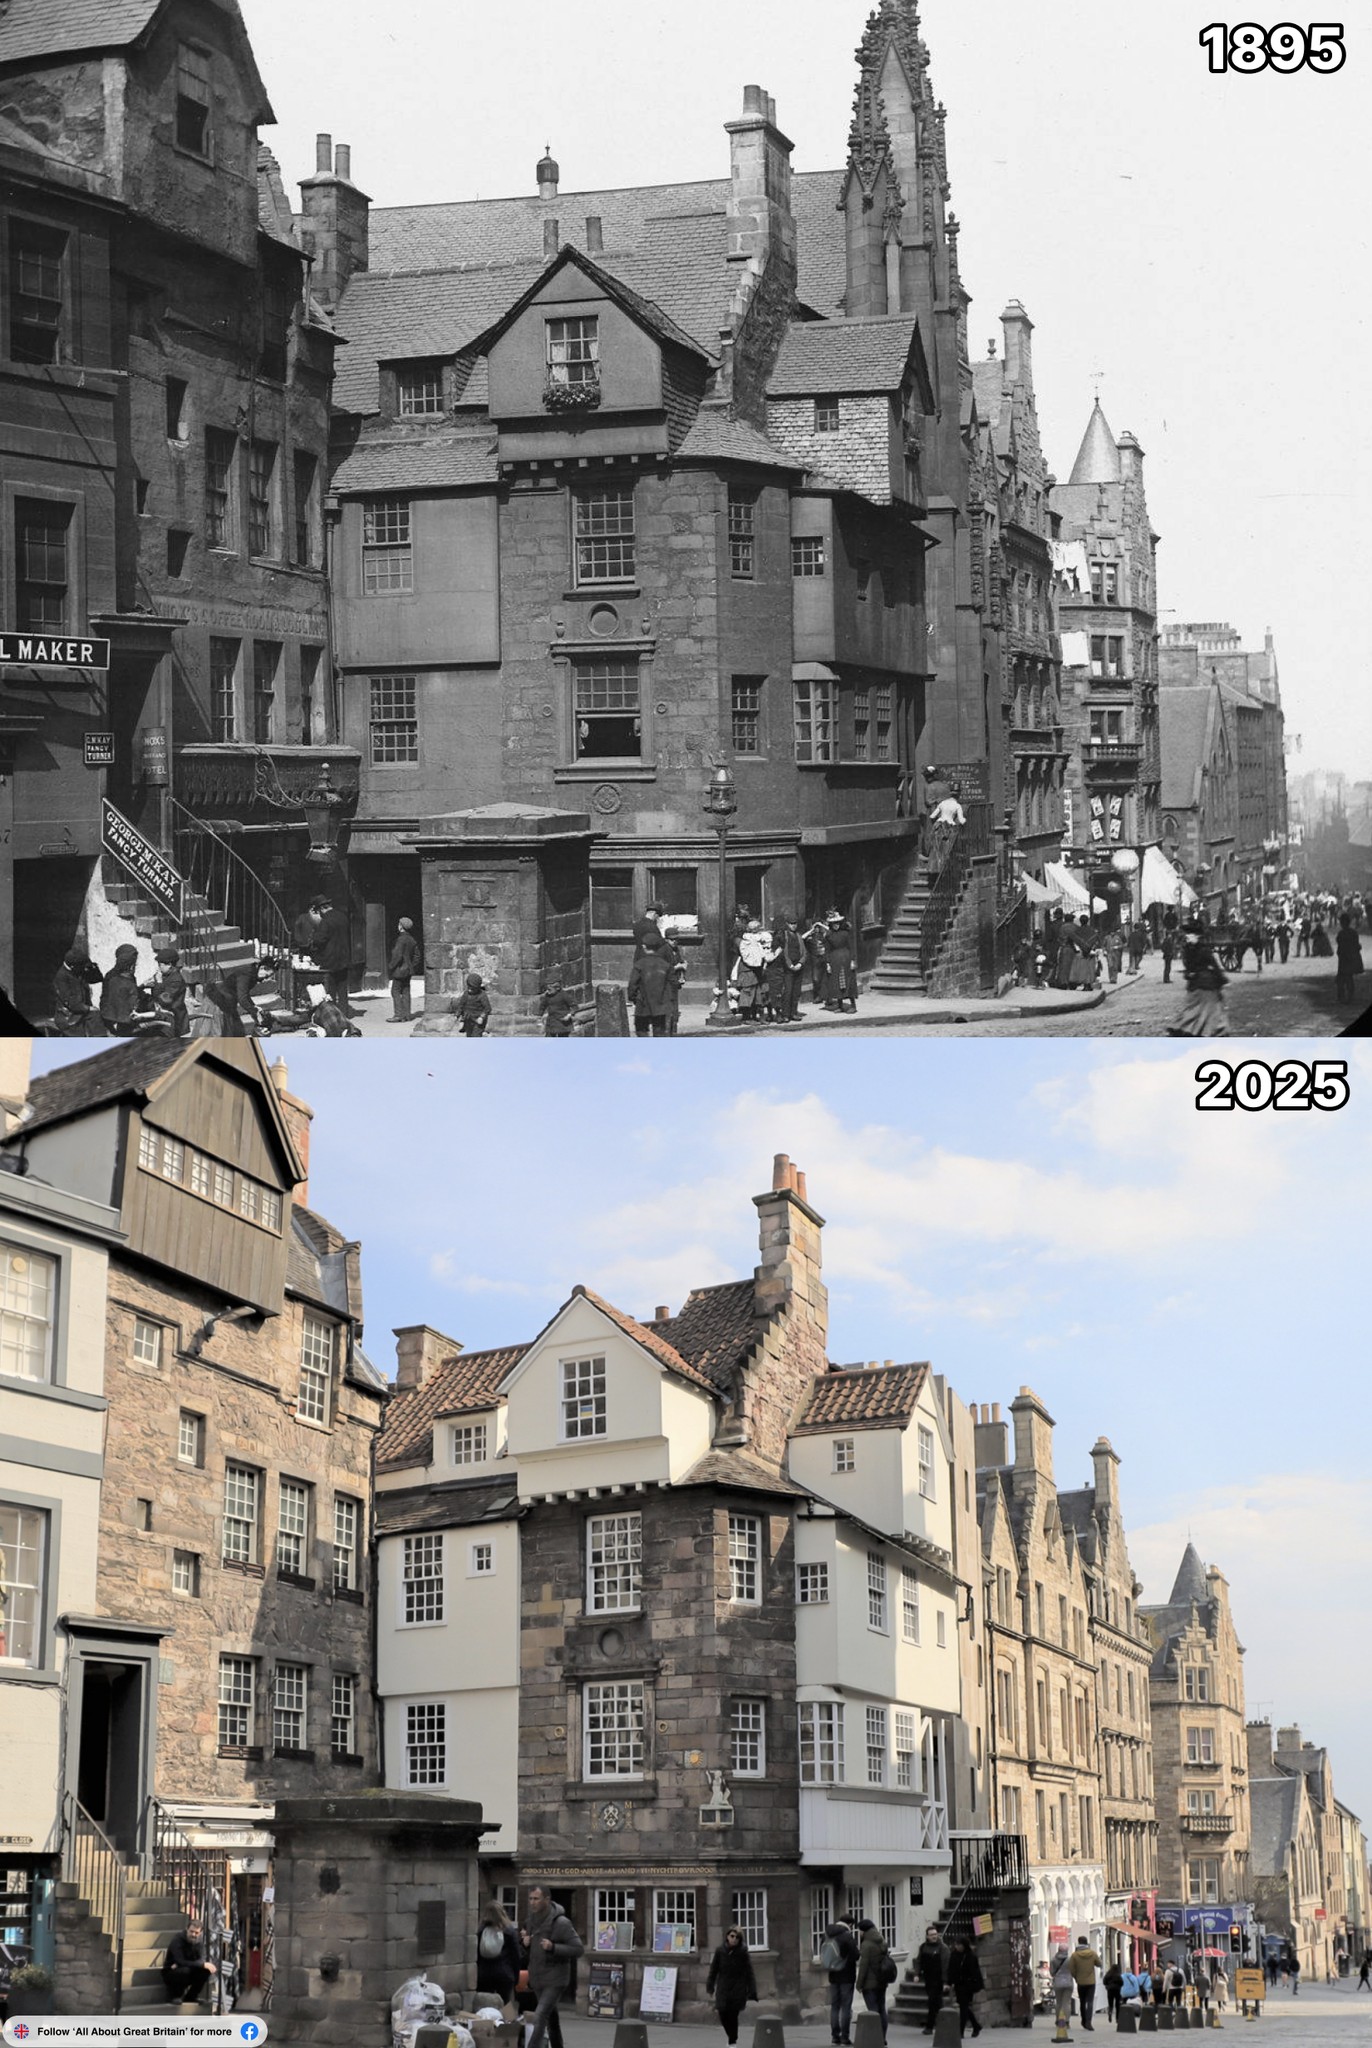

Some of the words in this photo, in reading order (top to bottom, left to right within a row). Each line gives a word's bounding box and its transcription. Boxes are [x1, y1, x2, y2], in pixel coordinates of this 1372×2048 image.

[18, 639, 94, 663] MAKER
[106, 811, 144, 853] GEORGE
[107, 826, 137, 858] FANCY
[136, 855, 175, 902] TURNER.
[478, 1838, 497, 1846] entre
